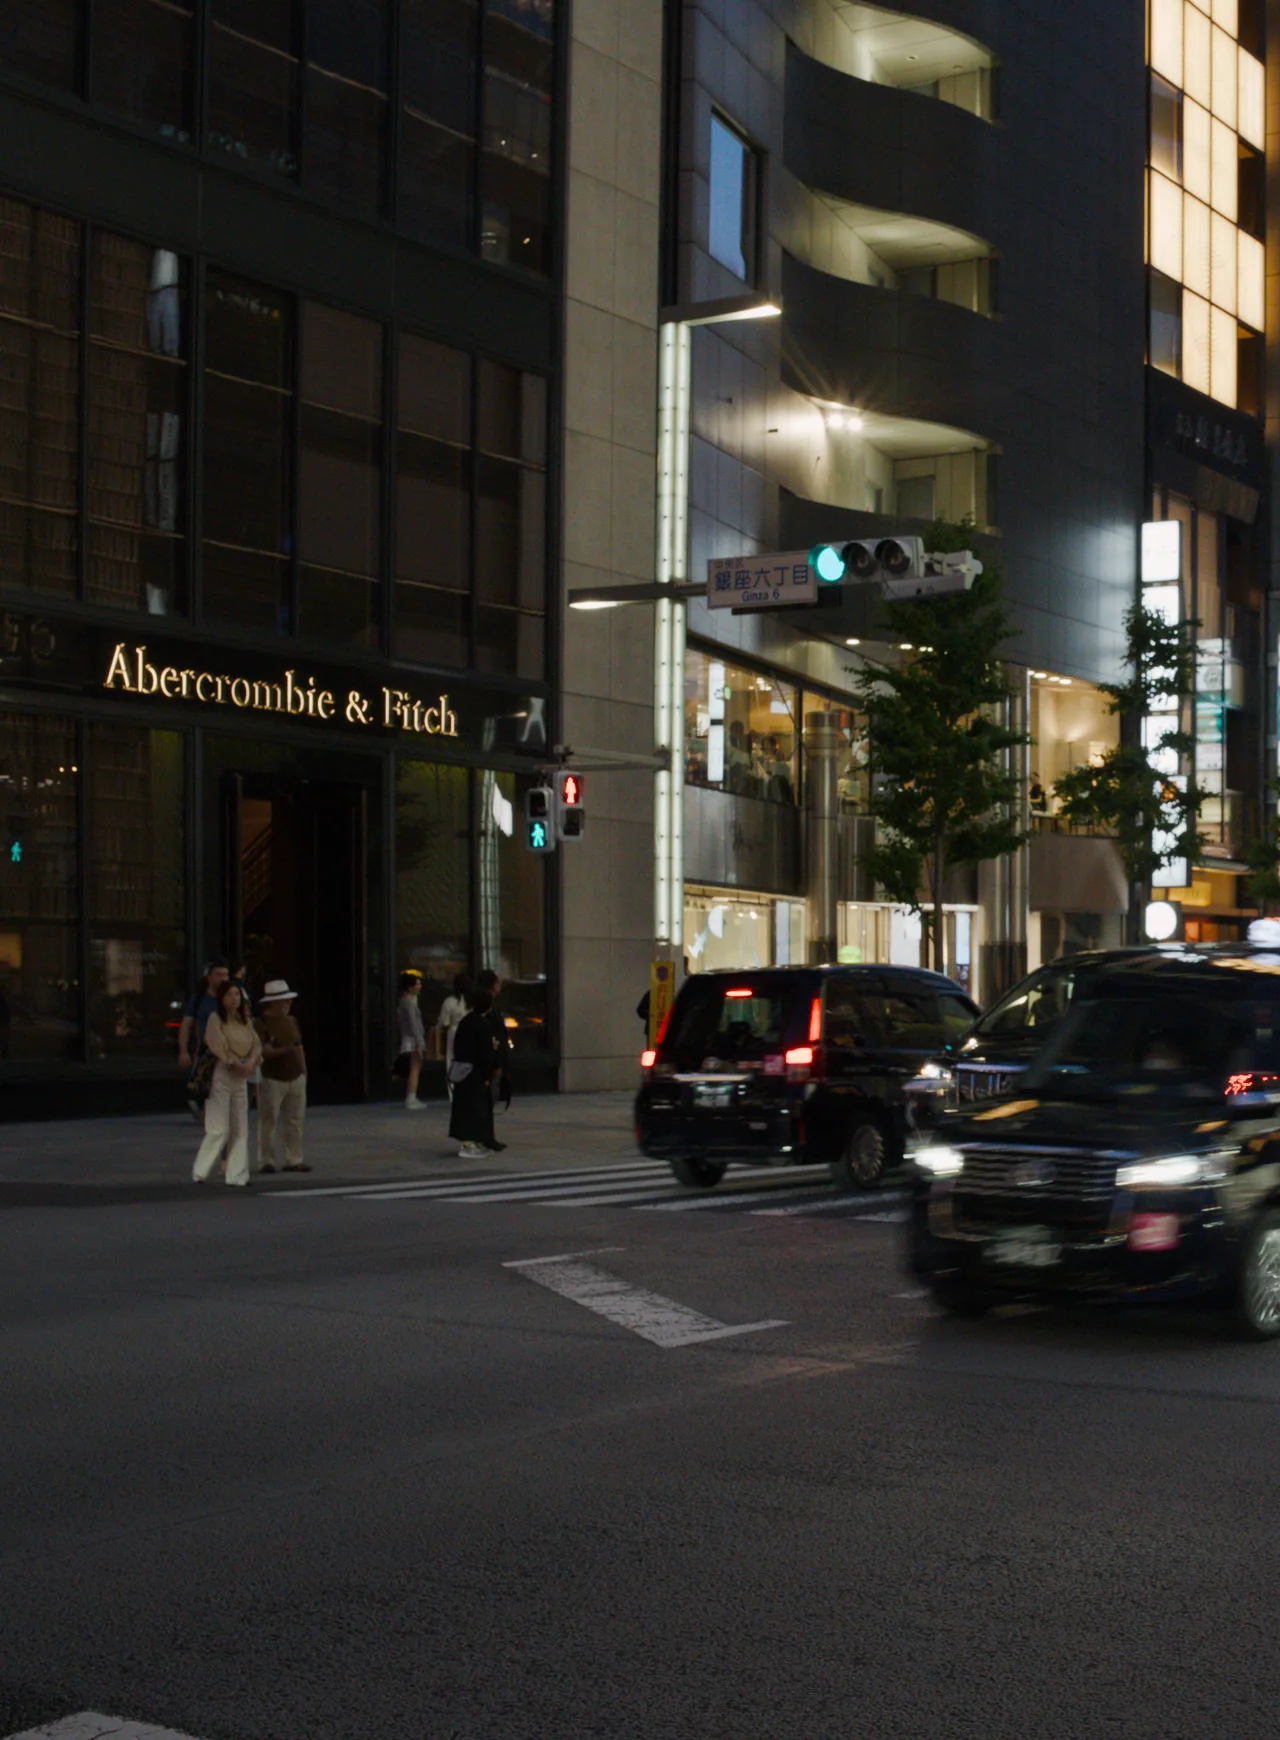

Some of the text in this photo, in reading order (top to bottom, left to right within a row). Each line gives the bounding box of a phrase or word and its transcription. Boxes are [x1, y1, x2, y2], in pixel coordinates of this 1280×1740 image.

[715, 558, 744, 569] 中央区
[715, 565, 808, 591] 銀座六丁目
[742, 588, 780, 602] Ginza 6
[103, 643, 459, 737] Abercrombie & Fitch
